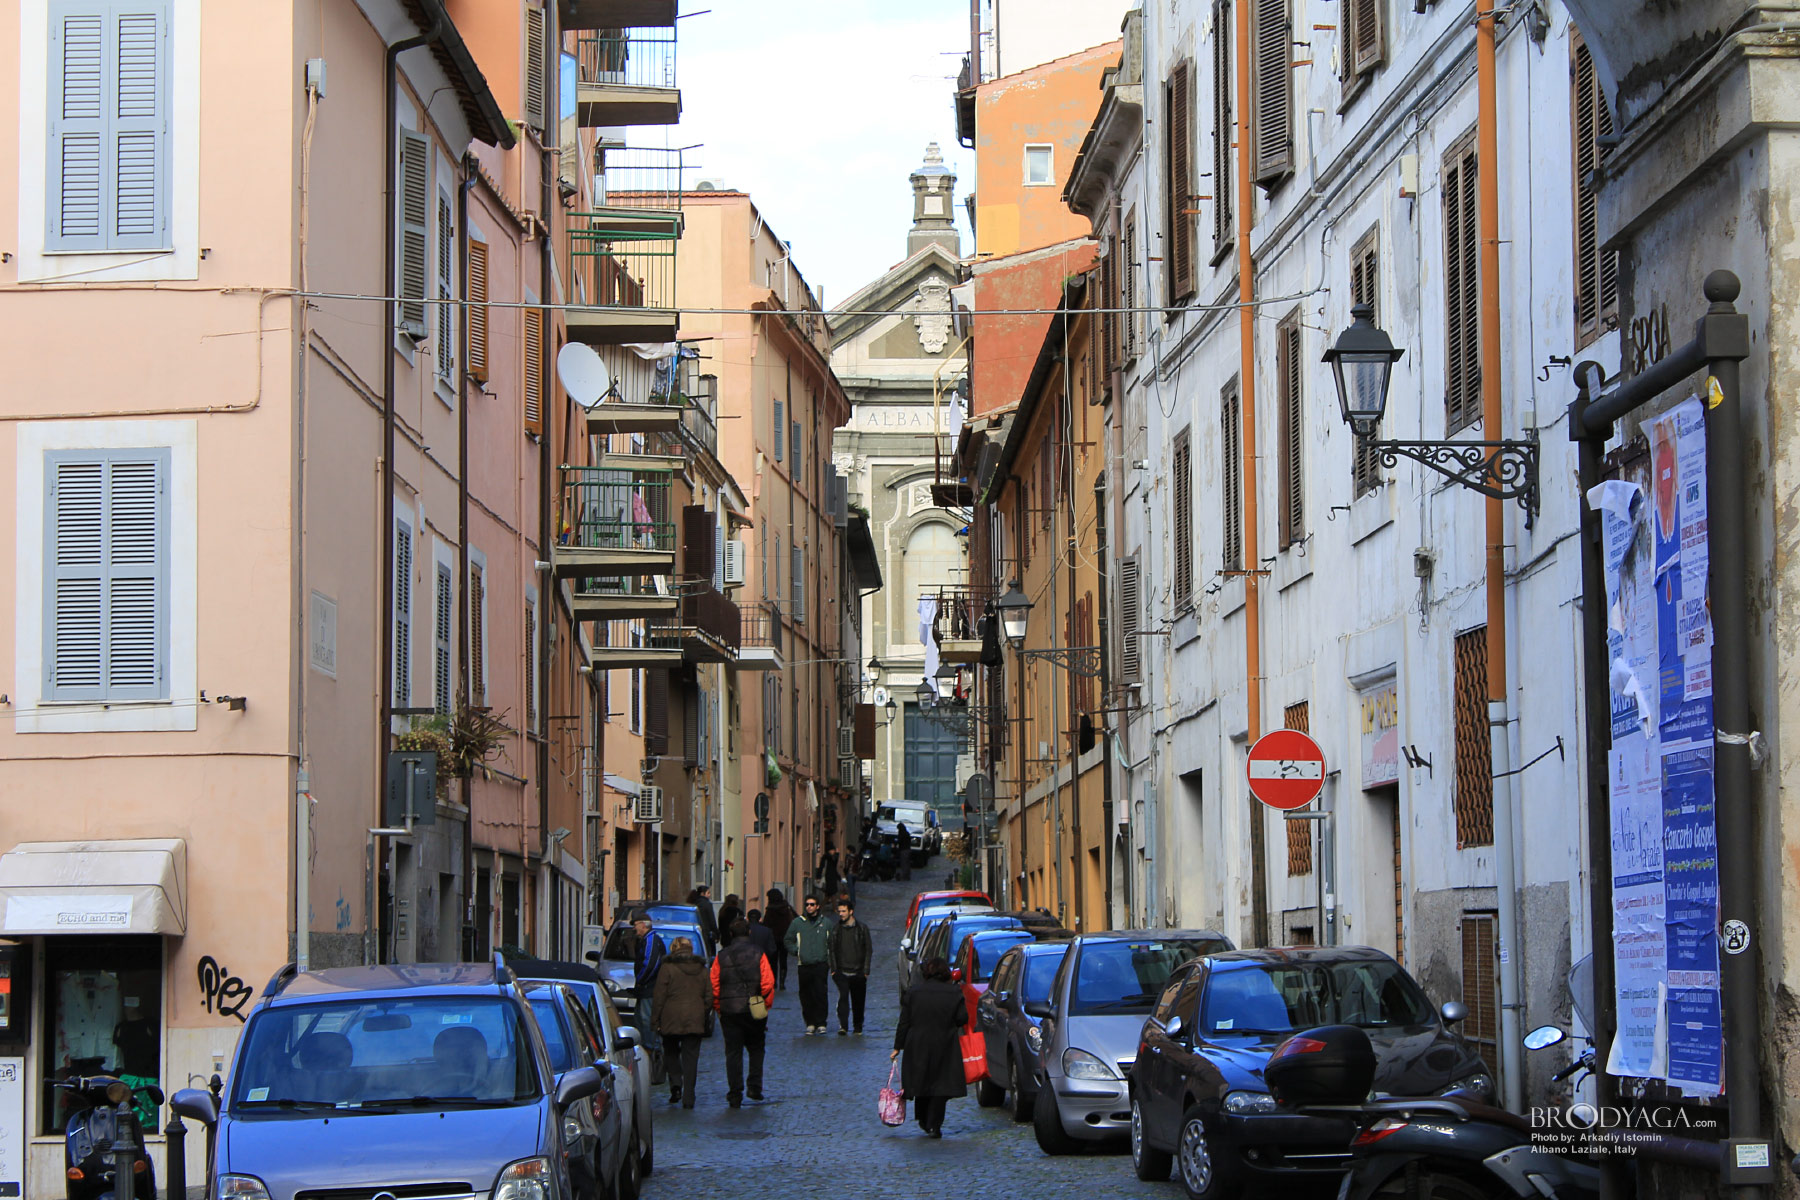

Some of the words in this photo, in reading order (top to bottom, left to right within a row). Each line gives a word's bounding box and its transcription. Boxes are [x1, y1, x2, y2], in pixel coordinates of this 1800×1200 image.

[1665, 824, 1693, 850] Concerto
[1694, 821, 1716, 851] Gospel
[60, 914, 88, 923] ECHO
[89, 914, 108, 922] and
